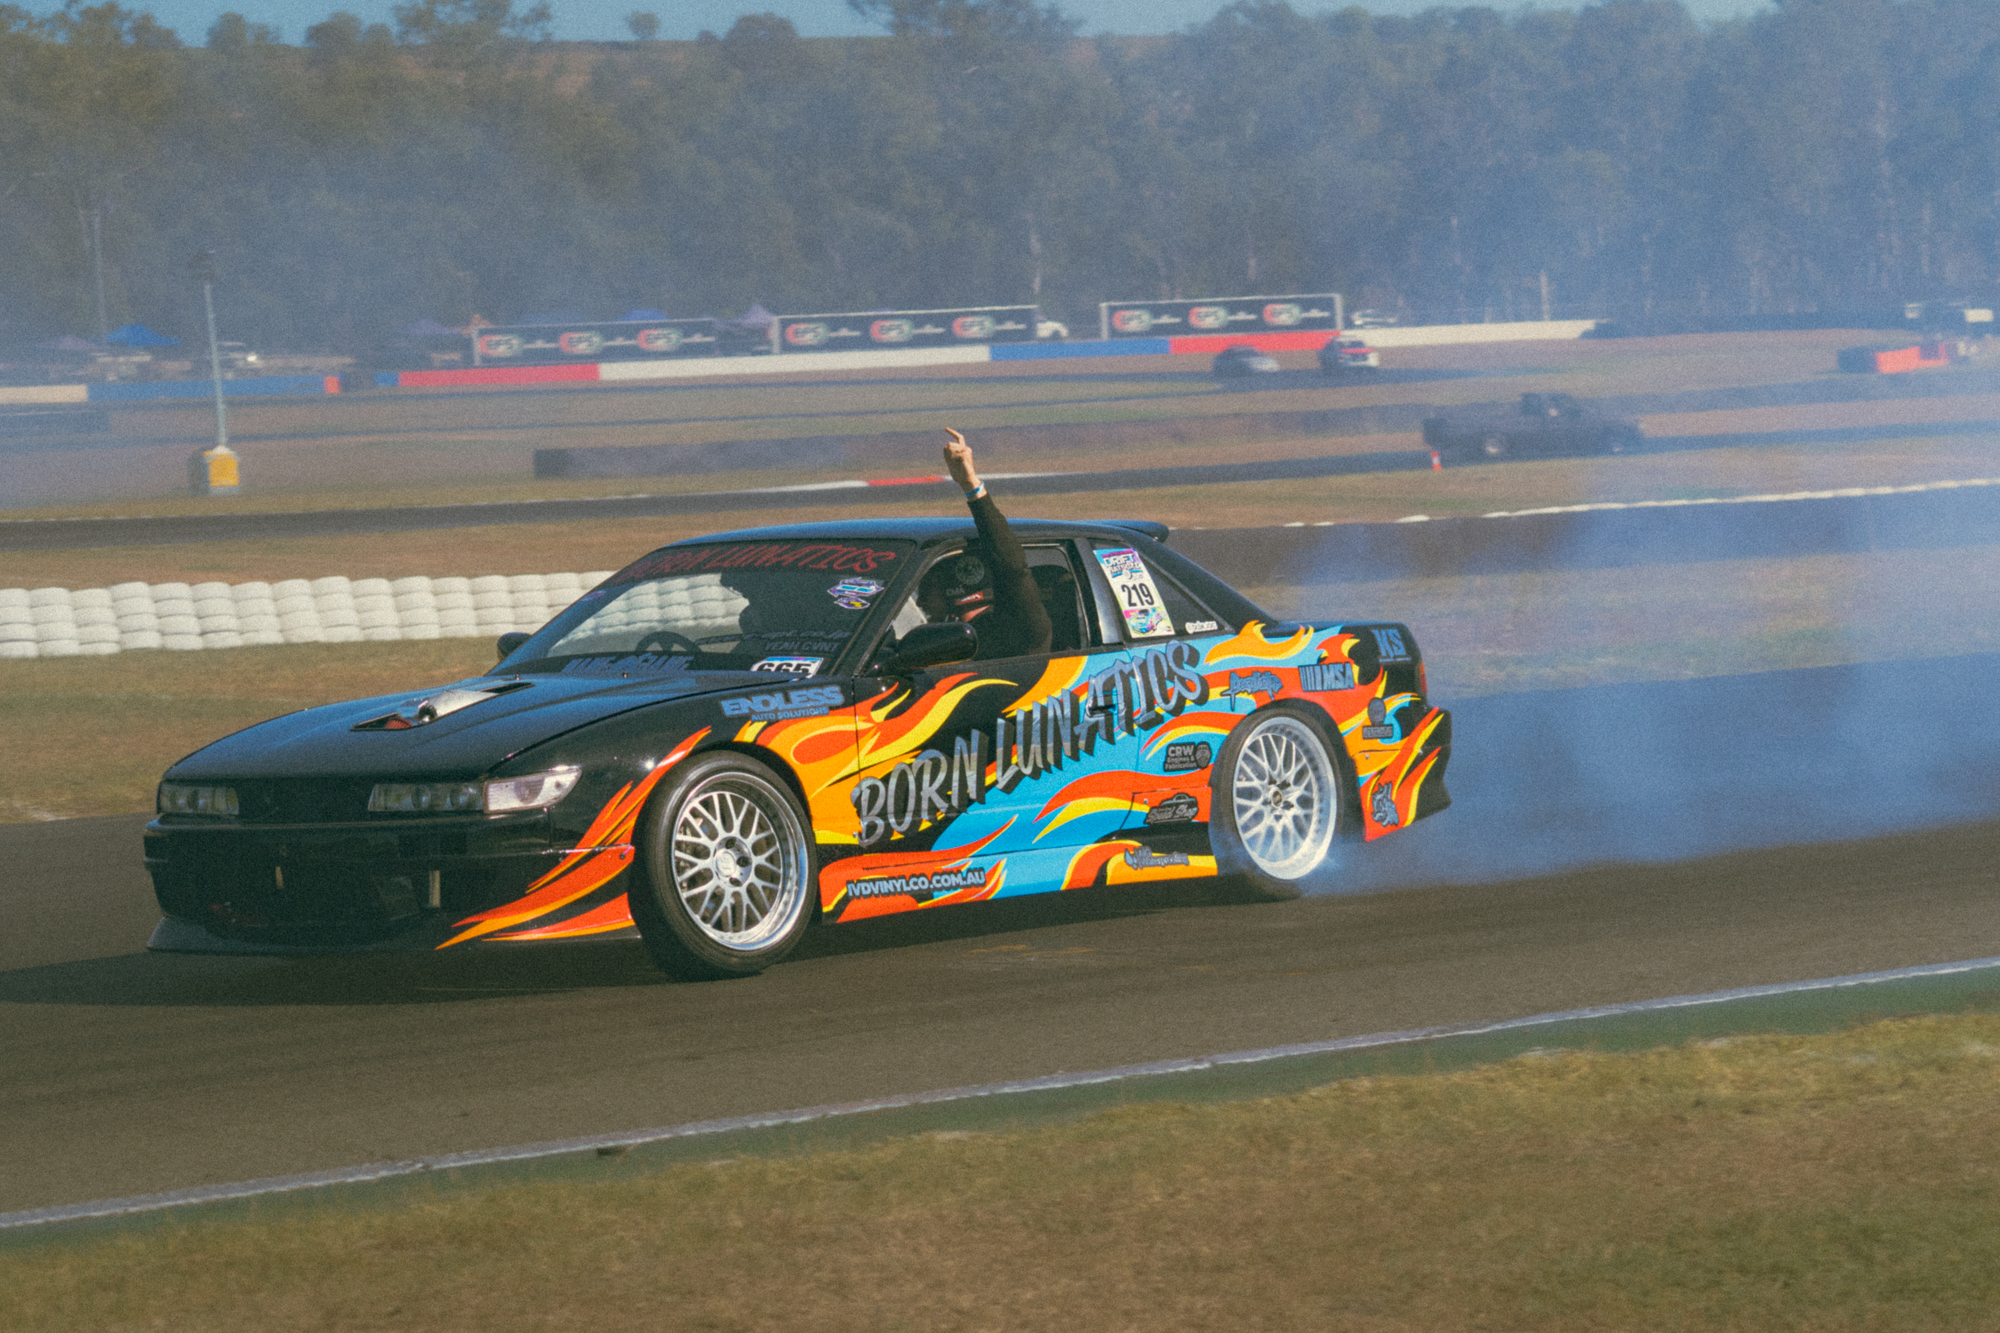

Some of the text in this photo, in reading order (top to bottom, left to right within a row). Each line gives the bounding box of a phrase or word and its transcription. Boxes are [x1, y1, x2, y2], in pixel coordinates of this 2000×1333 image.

[703, 543, 896, 573] LUNATICS
[1103, 553, 1135, 567] DRIFT
[1121, 582, 1155, 608] 219
[765, 641, 799, 652] YEAH
[720, 685, 845, 717] ENDLESS
[751, 706, 830, 722] AUTO SOLUTIONS
[850, 639, 1209, 848] BORN LUNATICS
[1168, 744, 1195, 758] CRW
[847, 870, 986, 897] IVDVINYLCO.COM.AU
